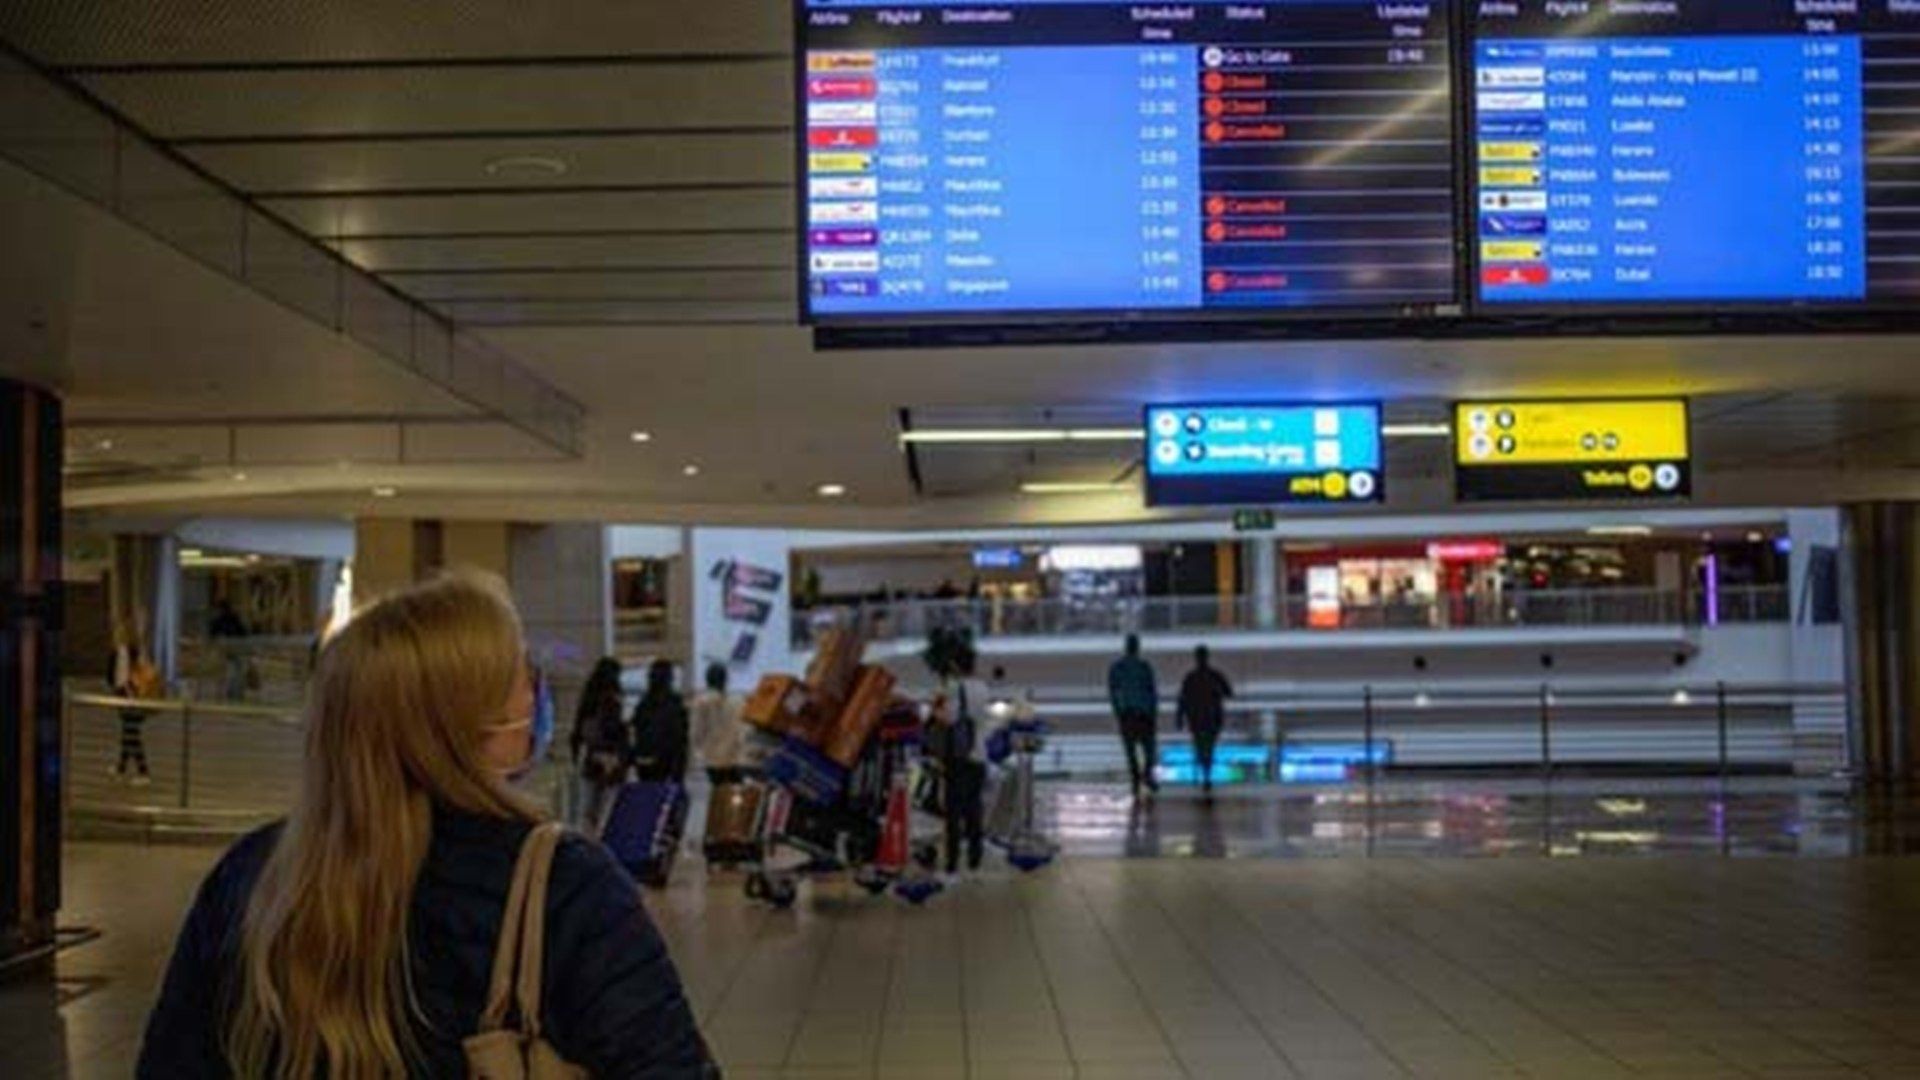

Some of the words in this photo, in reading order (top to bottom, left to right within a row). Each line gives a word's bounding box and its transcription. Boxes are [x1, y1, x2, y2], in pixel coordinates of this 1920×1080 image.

[942, 10, 1013, 23] Destination
[1131, 7, 1194, 21] Scheduled
[1225, 6, 1266, 20] Status
[1376, 4, 1431, 20] Updated
[1608, 0, 1679, 15] Destination
[943, 53, 1001, 68] Frankfurt
[1224, 49, 1245, 65] Go
[1246, 50, 1258, 65] to
[1259, 50, 1291, 65] Gate
[1226, 74, 1267, 89] Closed
[1226, 99, 1267, 114] Closed
[1226, 124, 1286, 139] Cancelled
[1227, 200, 1287, 214] Cancelled
[1227, 225, 1287, 239] Cancelled
[1227, 274, 1288, 289] Cancelled
